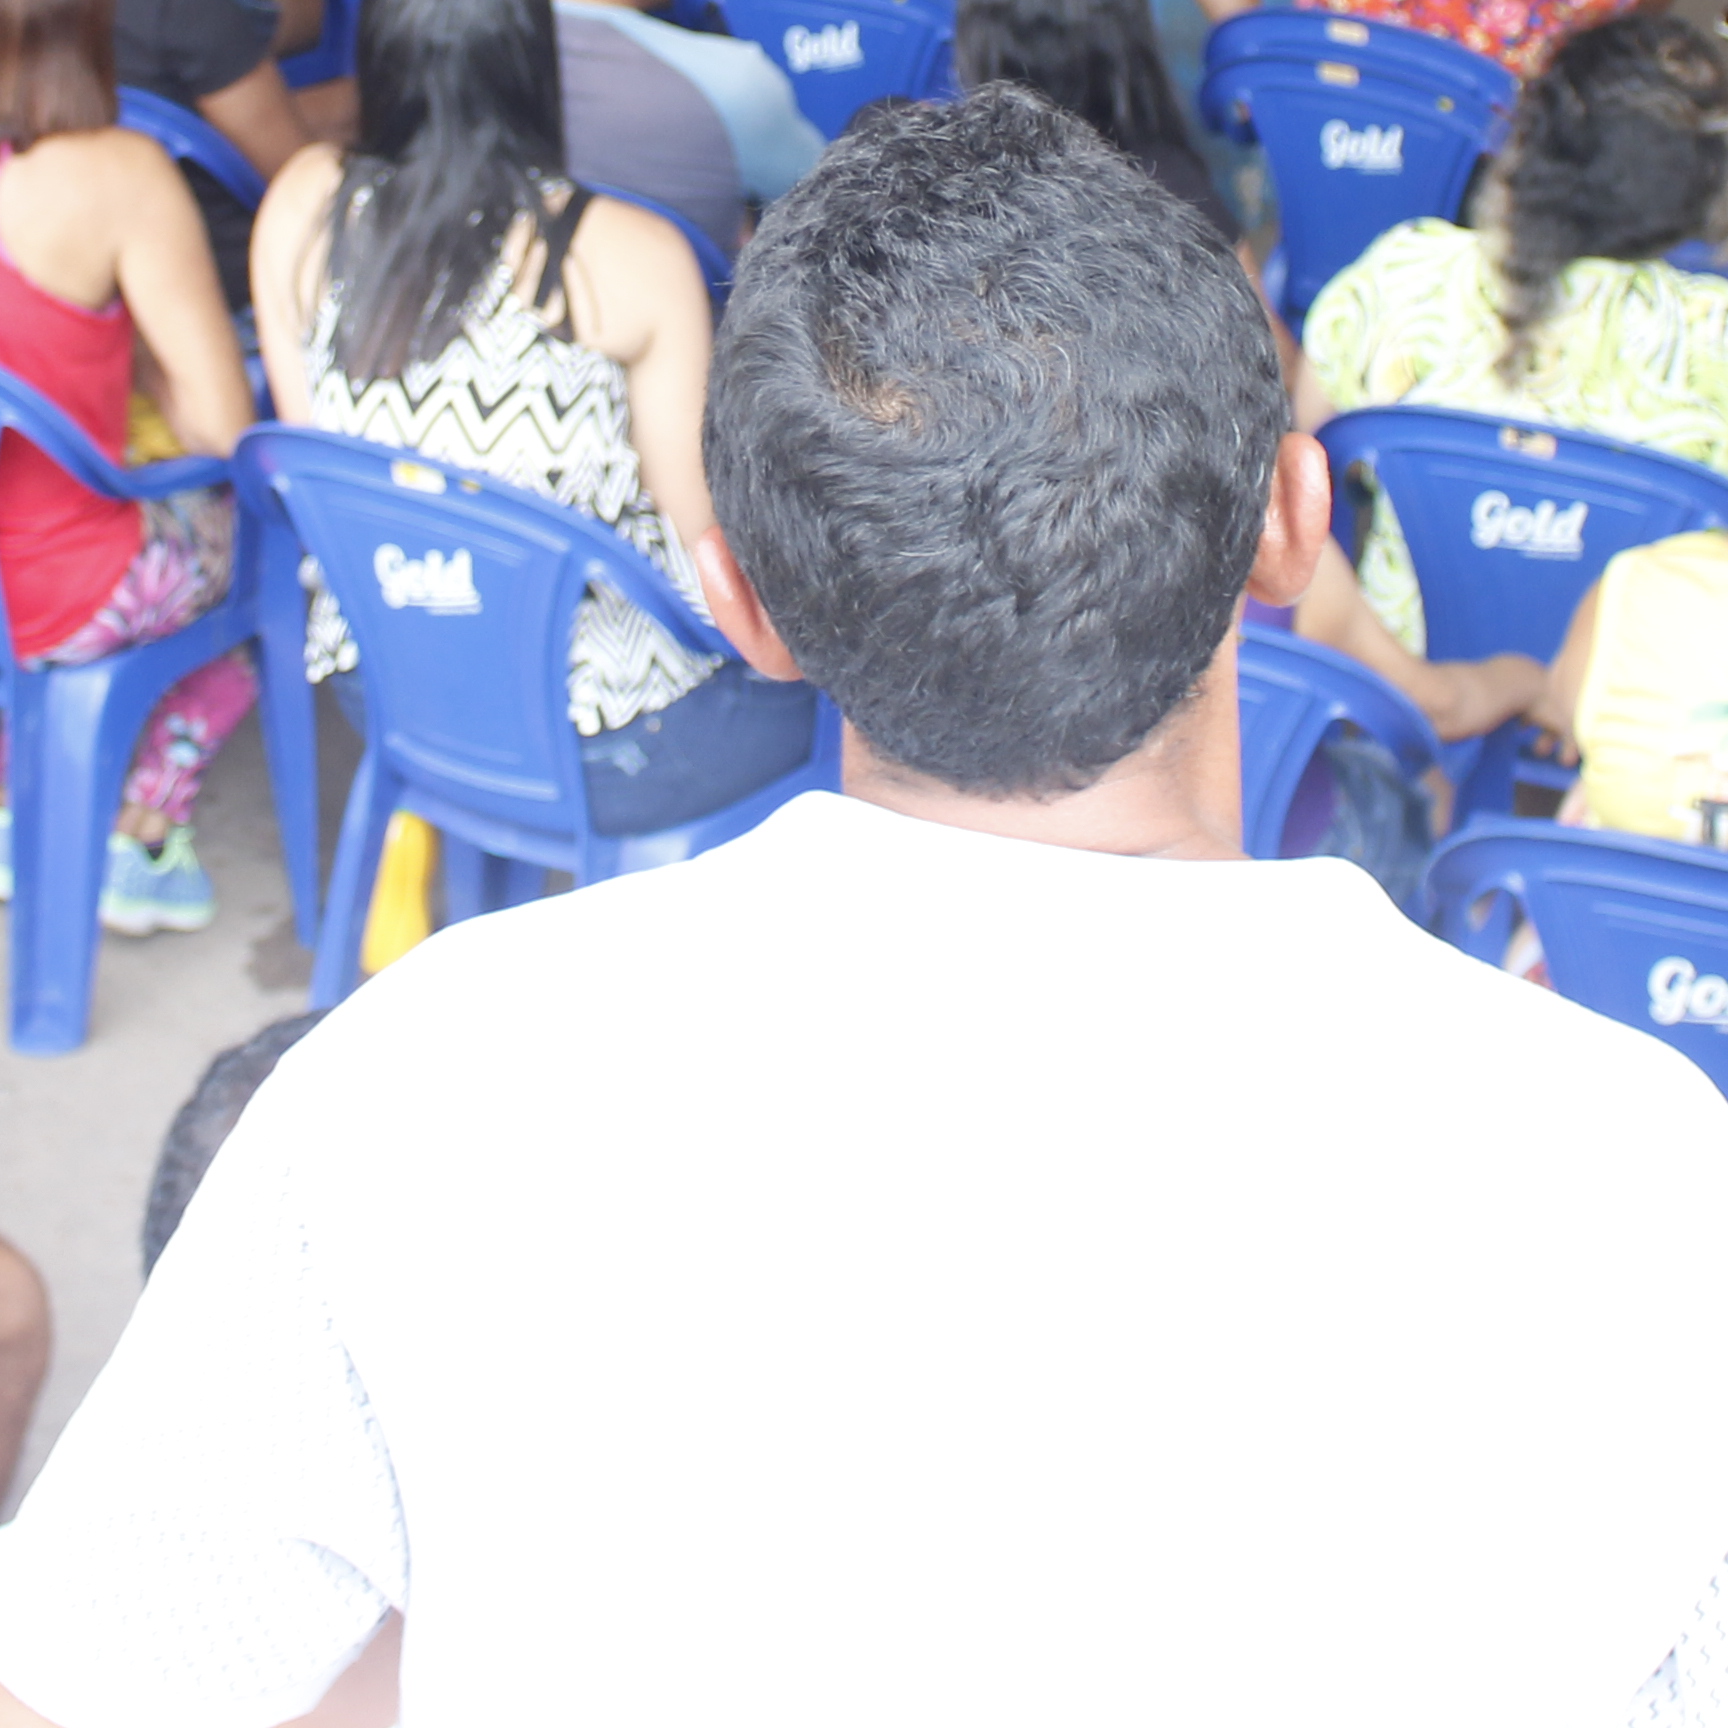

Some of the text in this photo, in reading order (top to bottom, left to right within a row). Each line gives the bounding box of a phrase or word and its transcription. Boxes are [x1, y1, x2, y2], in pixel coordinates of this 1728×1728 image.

[782, 20, 863, 73] Gold
[1319, 118, 1405, 170] Gold
[1471, 489, 1589, 550] Gold
[373, 542, 482, 610] Gold
